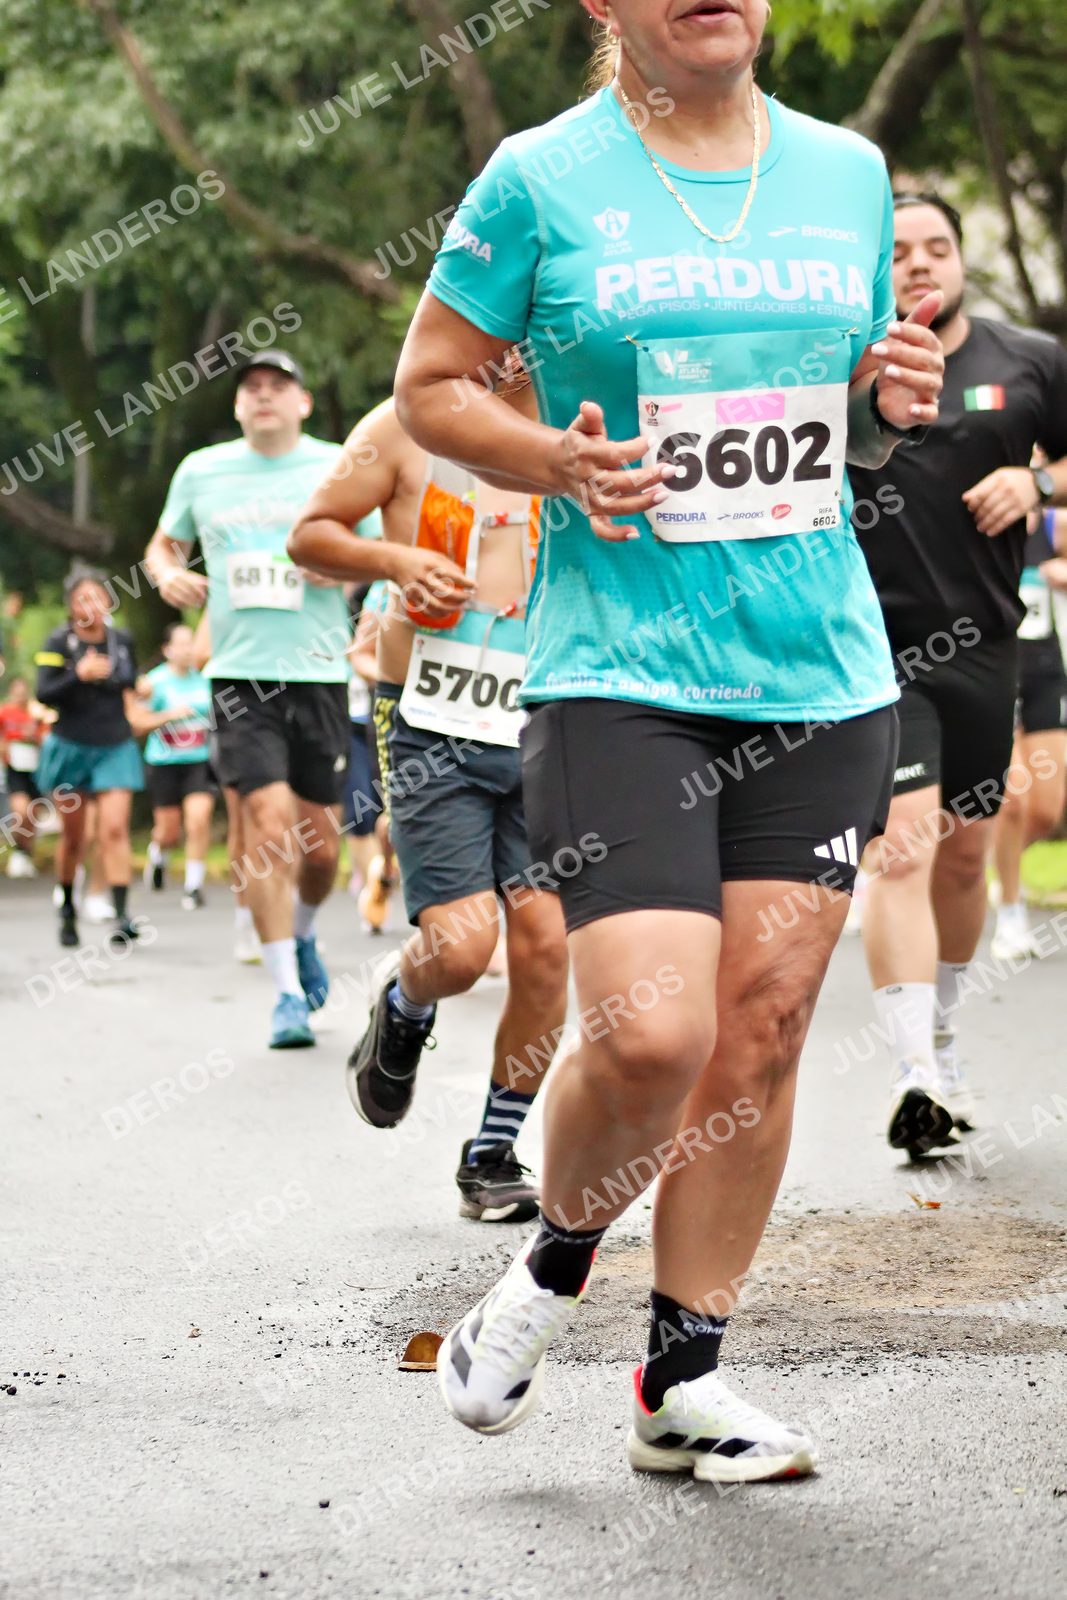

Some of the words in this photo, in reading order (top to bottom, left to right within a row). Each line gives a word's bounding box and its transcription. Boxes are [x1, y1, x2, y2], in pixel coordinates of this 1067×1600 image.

[801, 225, 859, 244] BROOKS
[594, 254, 870, 311] PERDURA
[617, 303, 656, 320] PEGA
[659, 300, 701, 313] PISOS
[656, 421, 831, 492] 6602
[656, 511, 706, 522] PERDURA
[732, 510, 765, 520] BROOKS
[818, 506, 833, 515] RIFA
[812, 515, 836, 527] 6602
[618, 679, 678, 699] amigos
[683, 682, 762, 700] corriendo
